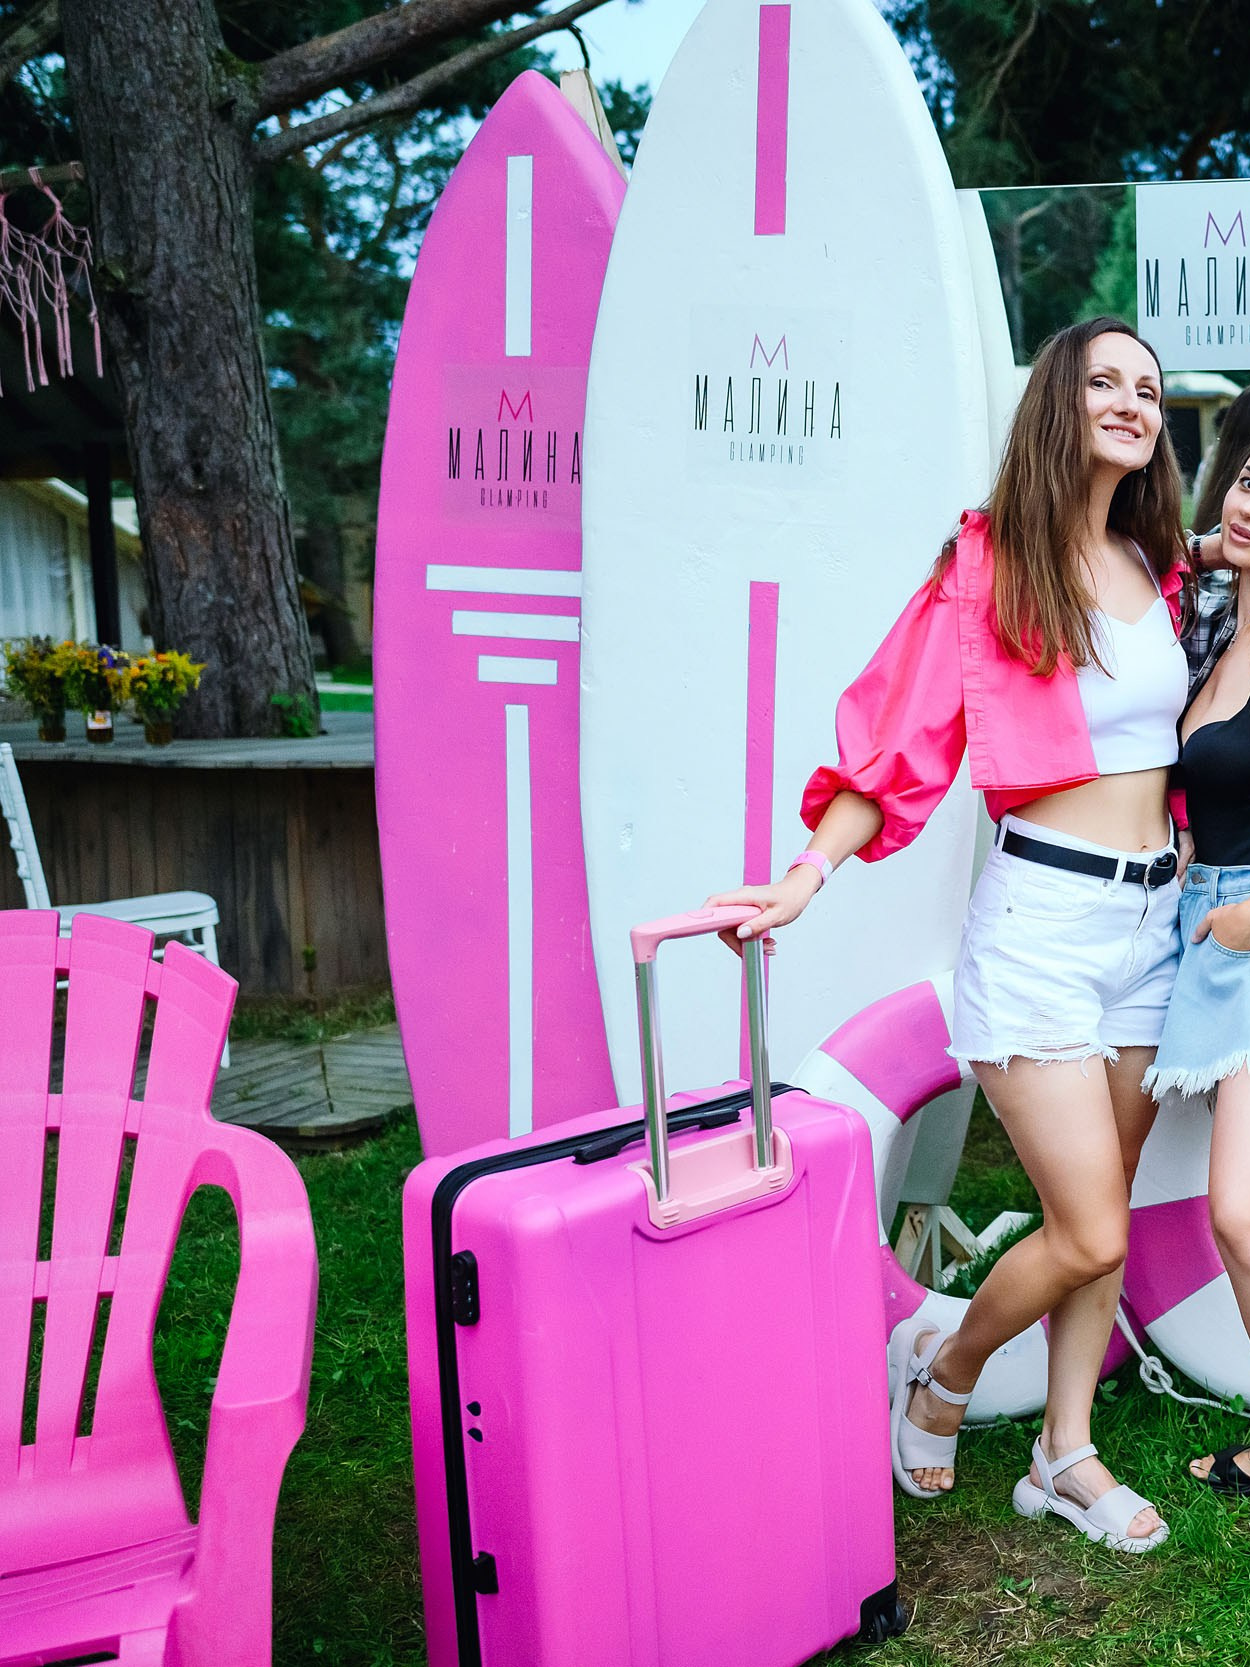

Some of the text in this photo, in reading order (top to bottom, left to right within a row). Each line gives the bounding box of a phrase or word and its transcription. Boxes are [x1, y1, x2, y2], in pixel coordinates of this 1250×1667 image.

[694, 373, 841, 440] МАЛИНА
[448, 427, 581, 485] МАЛИНА
[729, 440, 804, 466] GLAMPING
[480, 487, 548, 509] GLAMPING
